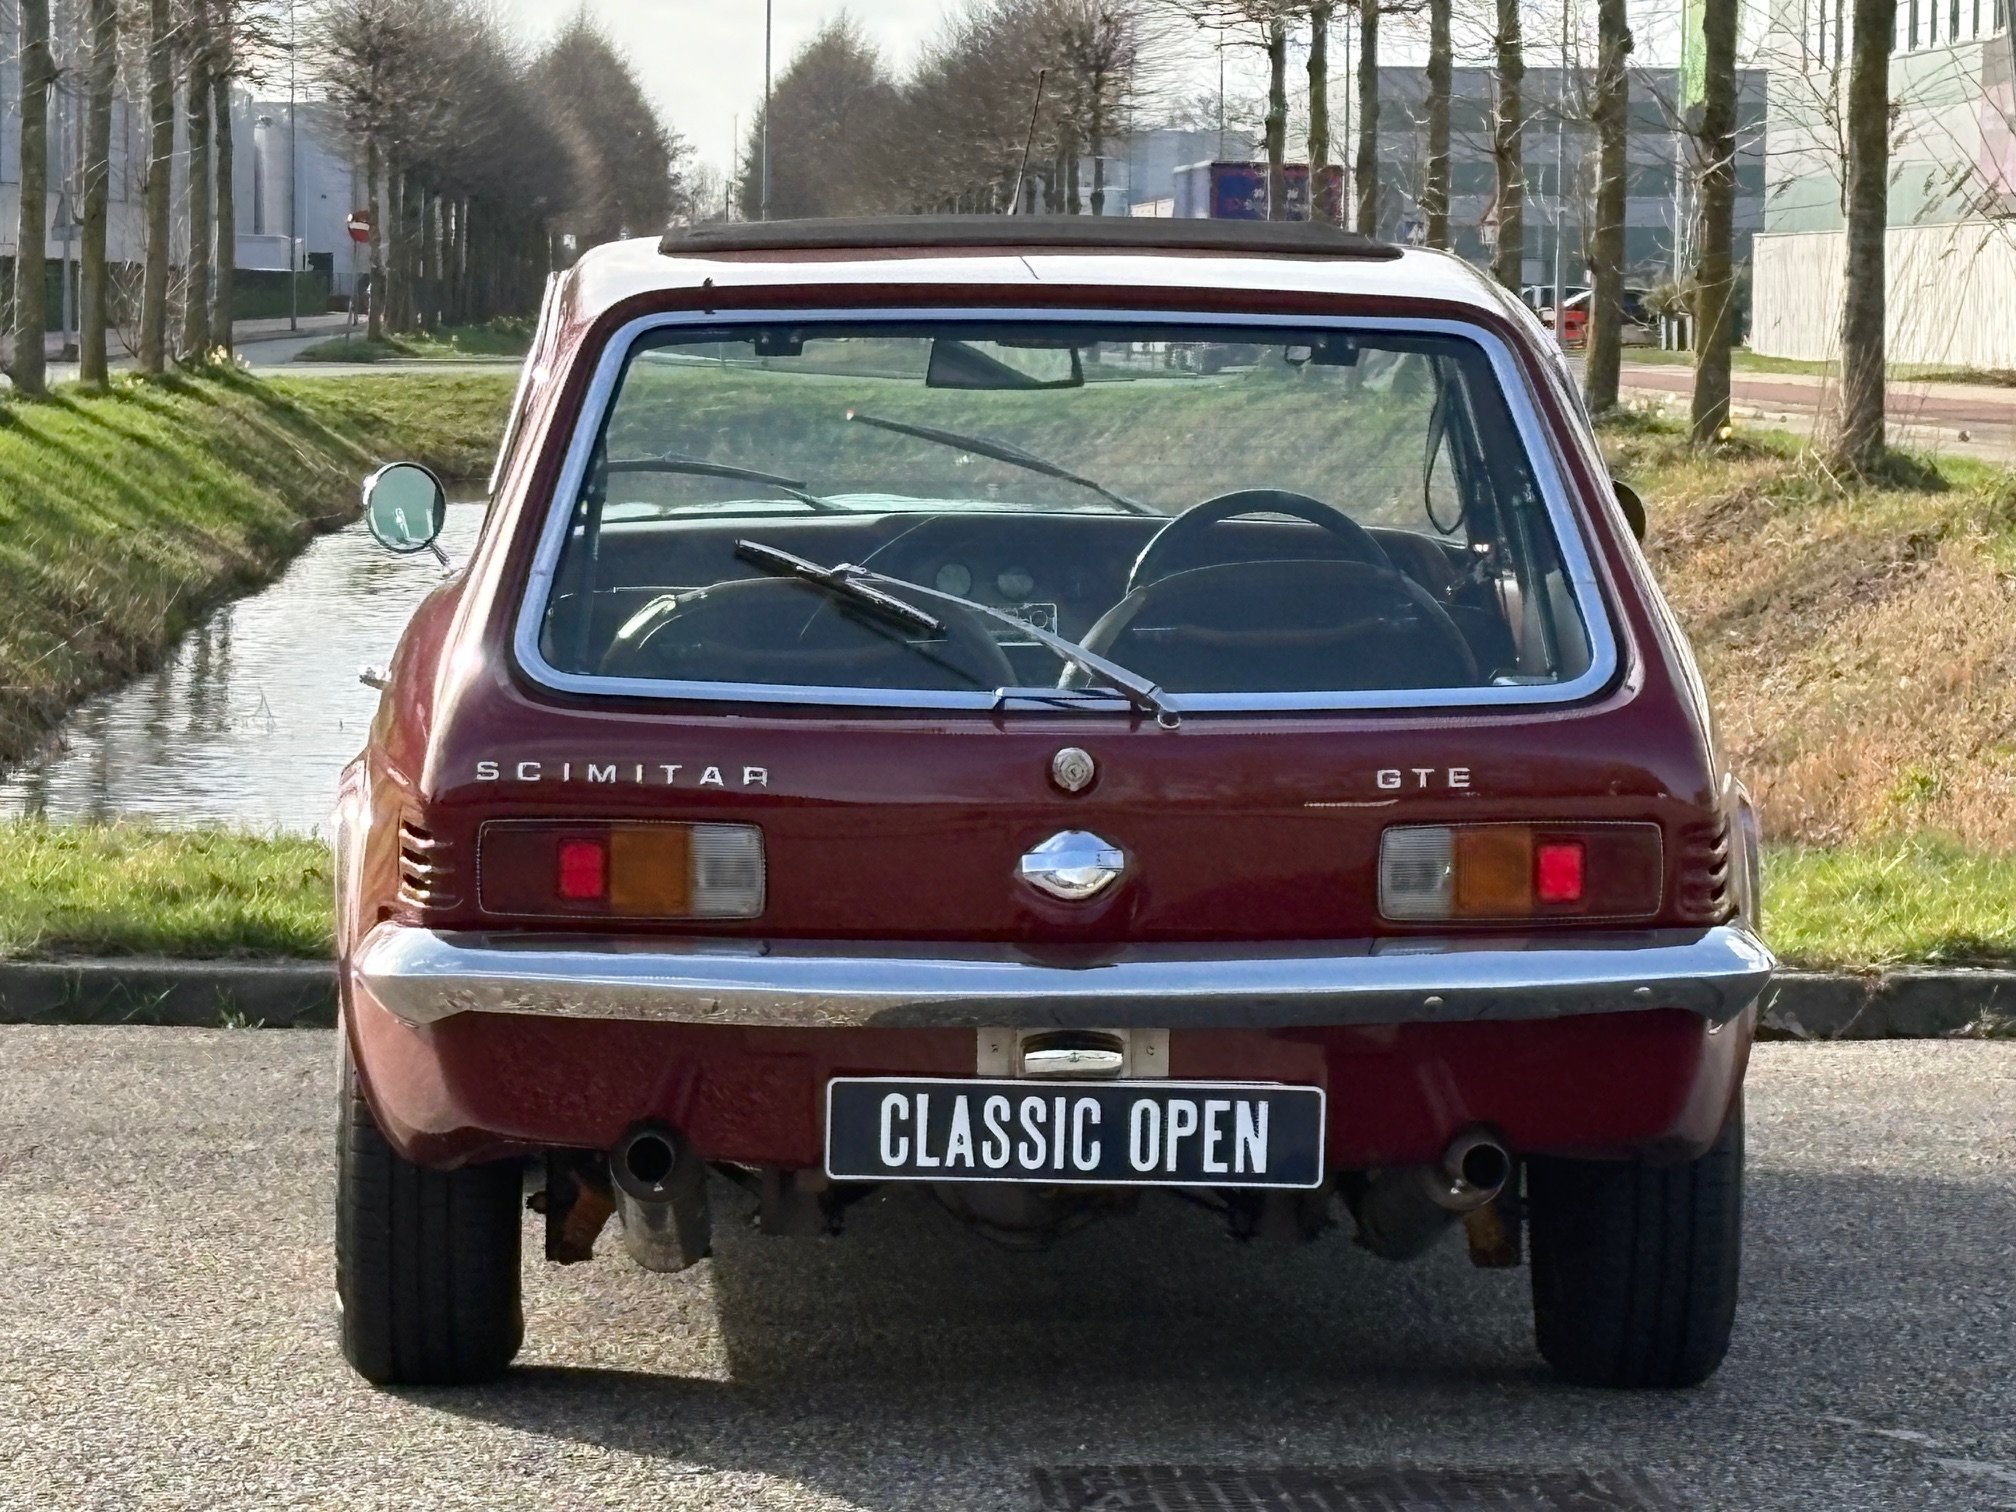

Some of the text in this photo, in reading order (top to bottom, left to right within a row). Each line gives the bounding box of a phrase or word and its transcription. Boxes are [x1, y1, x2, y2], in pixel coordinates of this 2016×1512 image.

[476, 761, 769, 787] SCIMITAR
[1377, 767, 1471, 789] GTE
[880, 1093, 1269, 1173] CLASSIC OPEN
